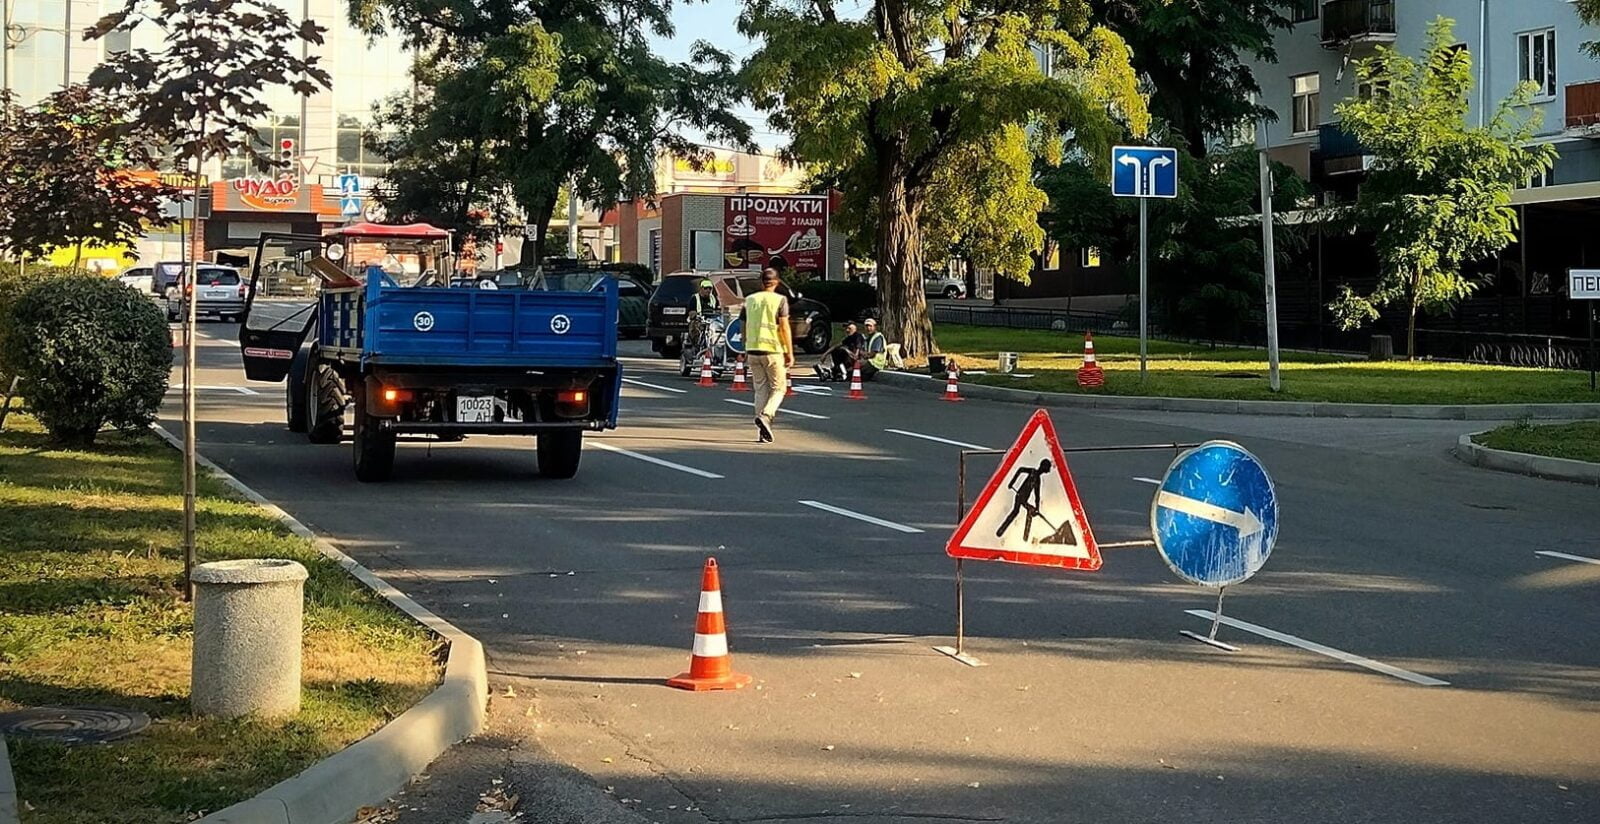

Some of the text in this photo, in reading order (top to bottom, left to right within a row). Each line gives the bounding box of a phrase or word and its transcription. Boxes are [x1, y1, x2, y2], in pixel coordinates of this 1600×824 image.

[233, 178, 294, 197] ЧУДО
[730, 198, 823, 214] ПРОДУКТИ
[418, 317, 430, 326] 30
[460, 399, 491, 410] 10023
